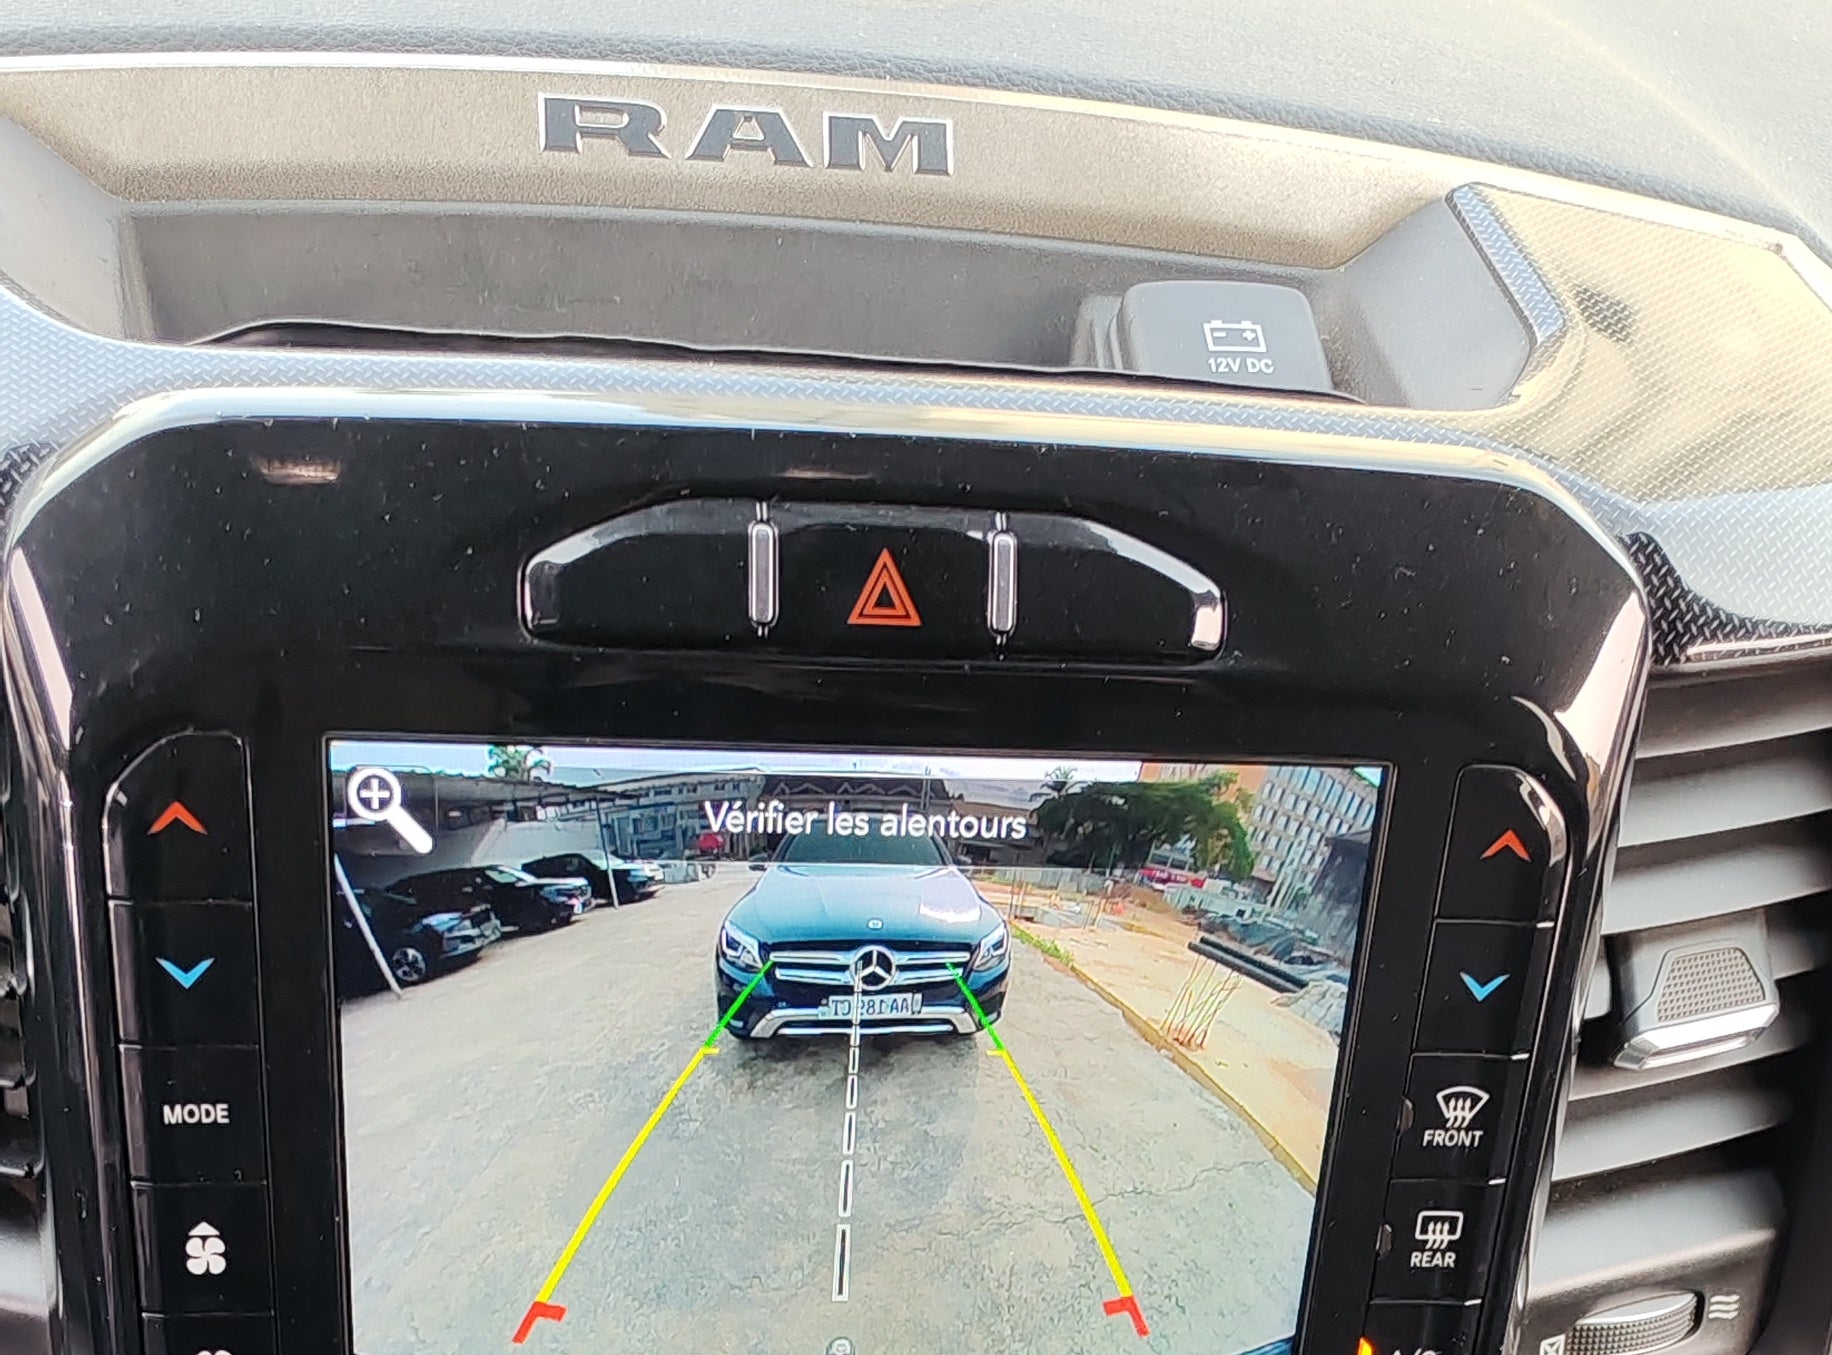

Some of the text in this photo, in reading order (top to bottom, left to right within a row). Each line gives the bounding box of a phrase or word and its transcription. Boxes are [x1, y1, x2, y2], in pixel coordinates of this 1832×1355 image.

[537, 92, 954, 177] RAM
[1207, 357, 1275, 374] 12V DC
[703, 800, 1028, 839] Vérifier les alentours
[163, 1103, 230, 1125] MODE
[1422, 1129, 1484, 1147] FRONT
[1410, 1251, 1456, 1268] REAR
